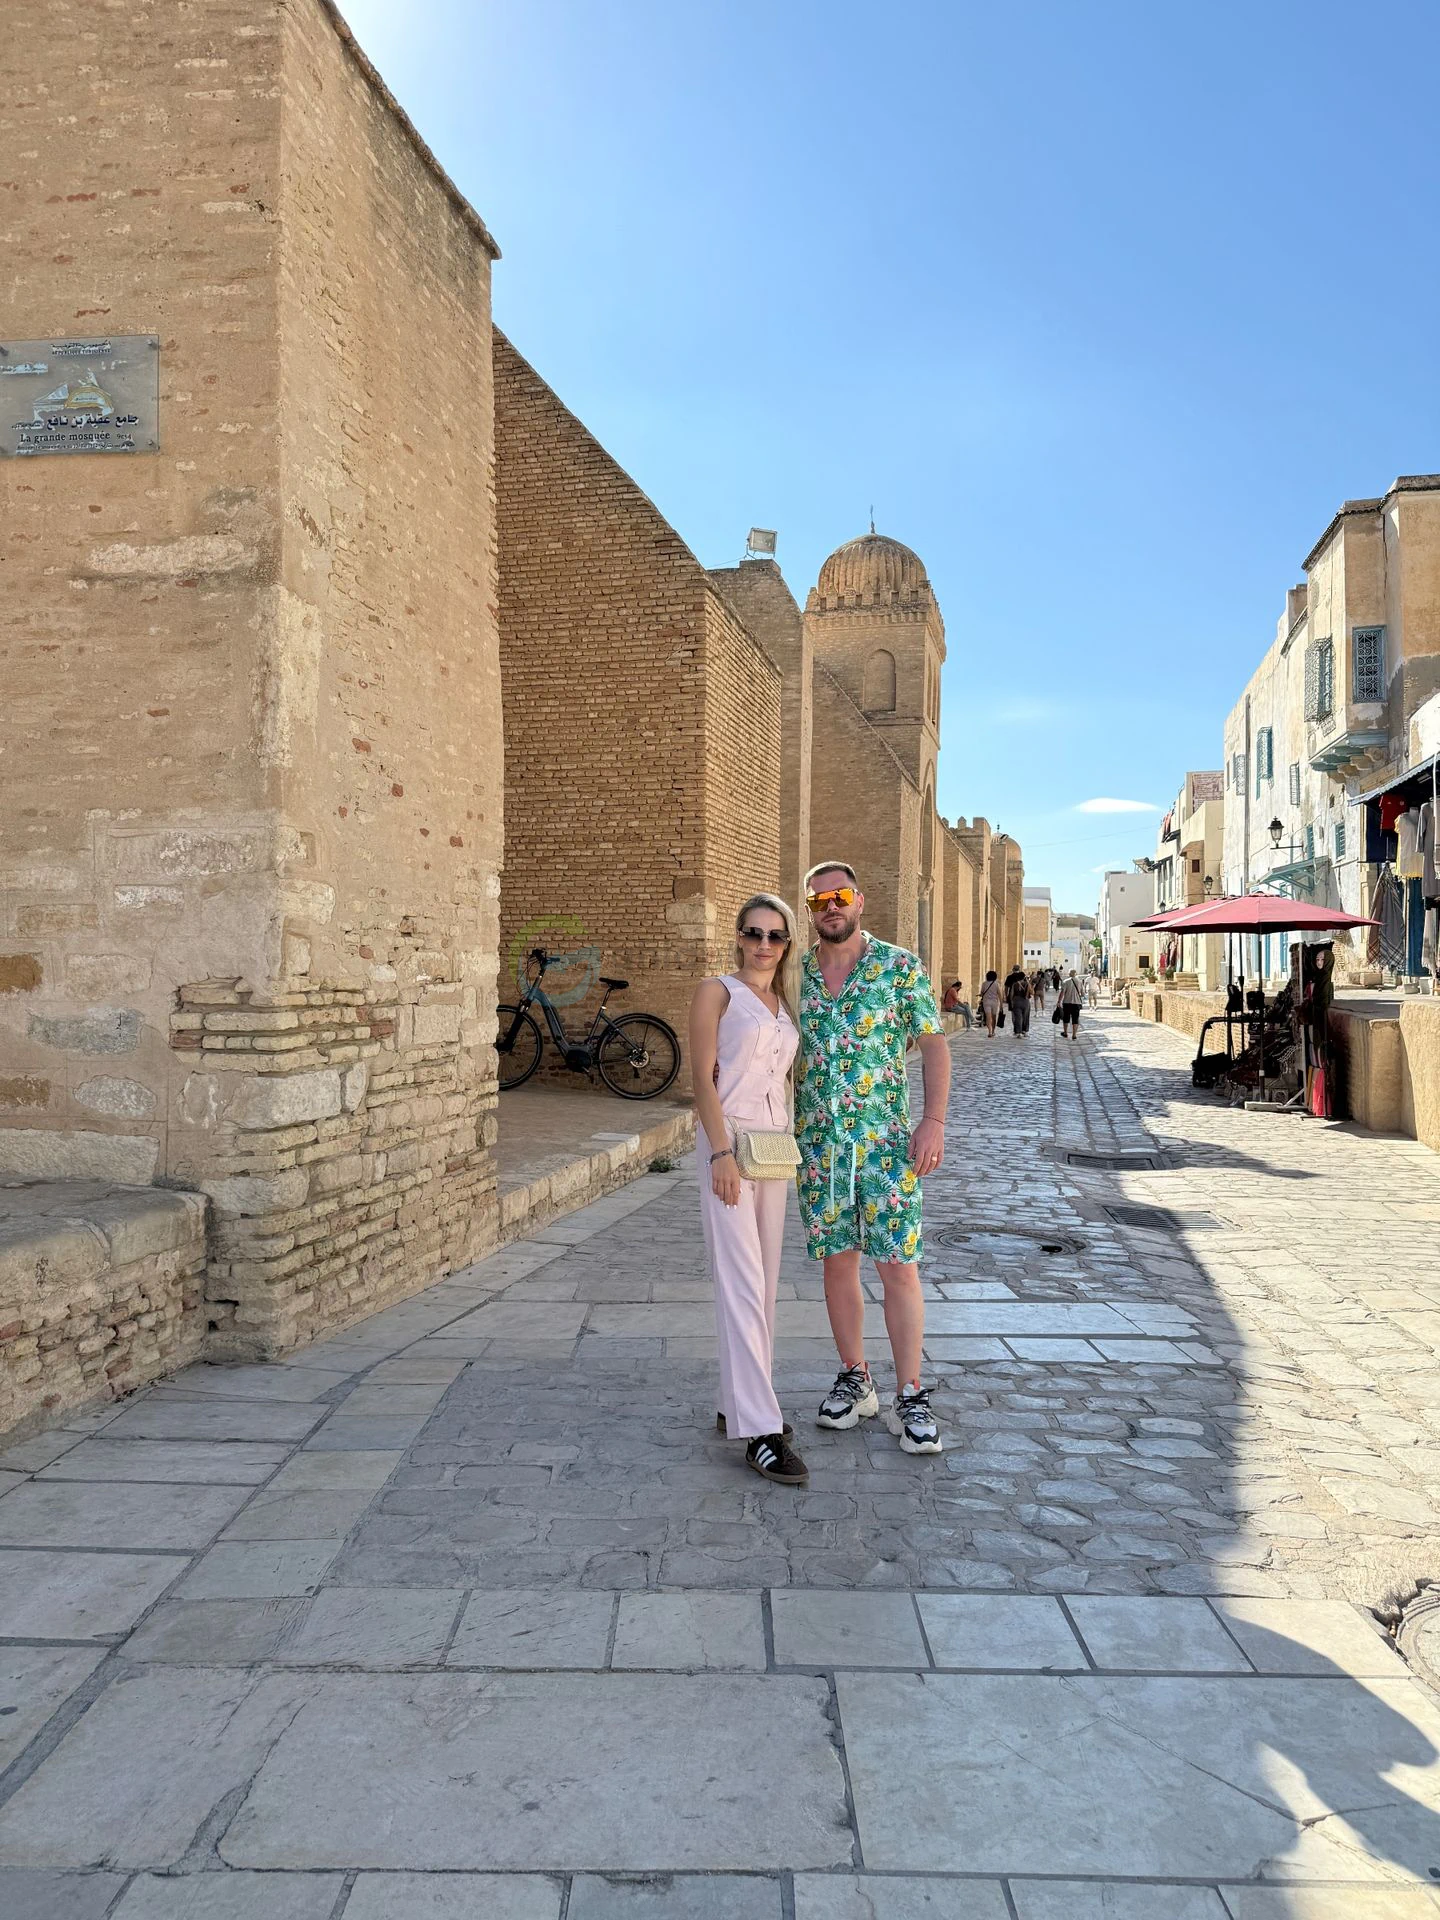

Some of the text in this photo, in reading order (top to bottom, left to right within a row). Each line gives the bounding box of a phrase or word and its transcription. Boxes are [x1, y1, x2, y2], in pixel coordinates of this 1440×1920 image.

[47, 415, 69, 430] نافع
[71, 415, 83, 428] بن
[86, 413, 111, 429] عقبة
[115, 414, 139, 428] جامع
[20, 433, 31, 442] La
[34, 432, 66, 443] grande
[69, 430, 111, 443] mosquée
